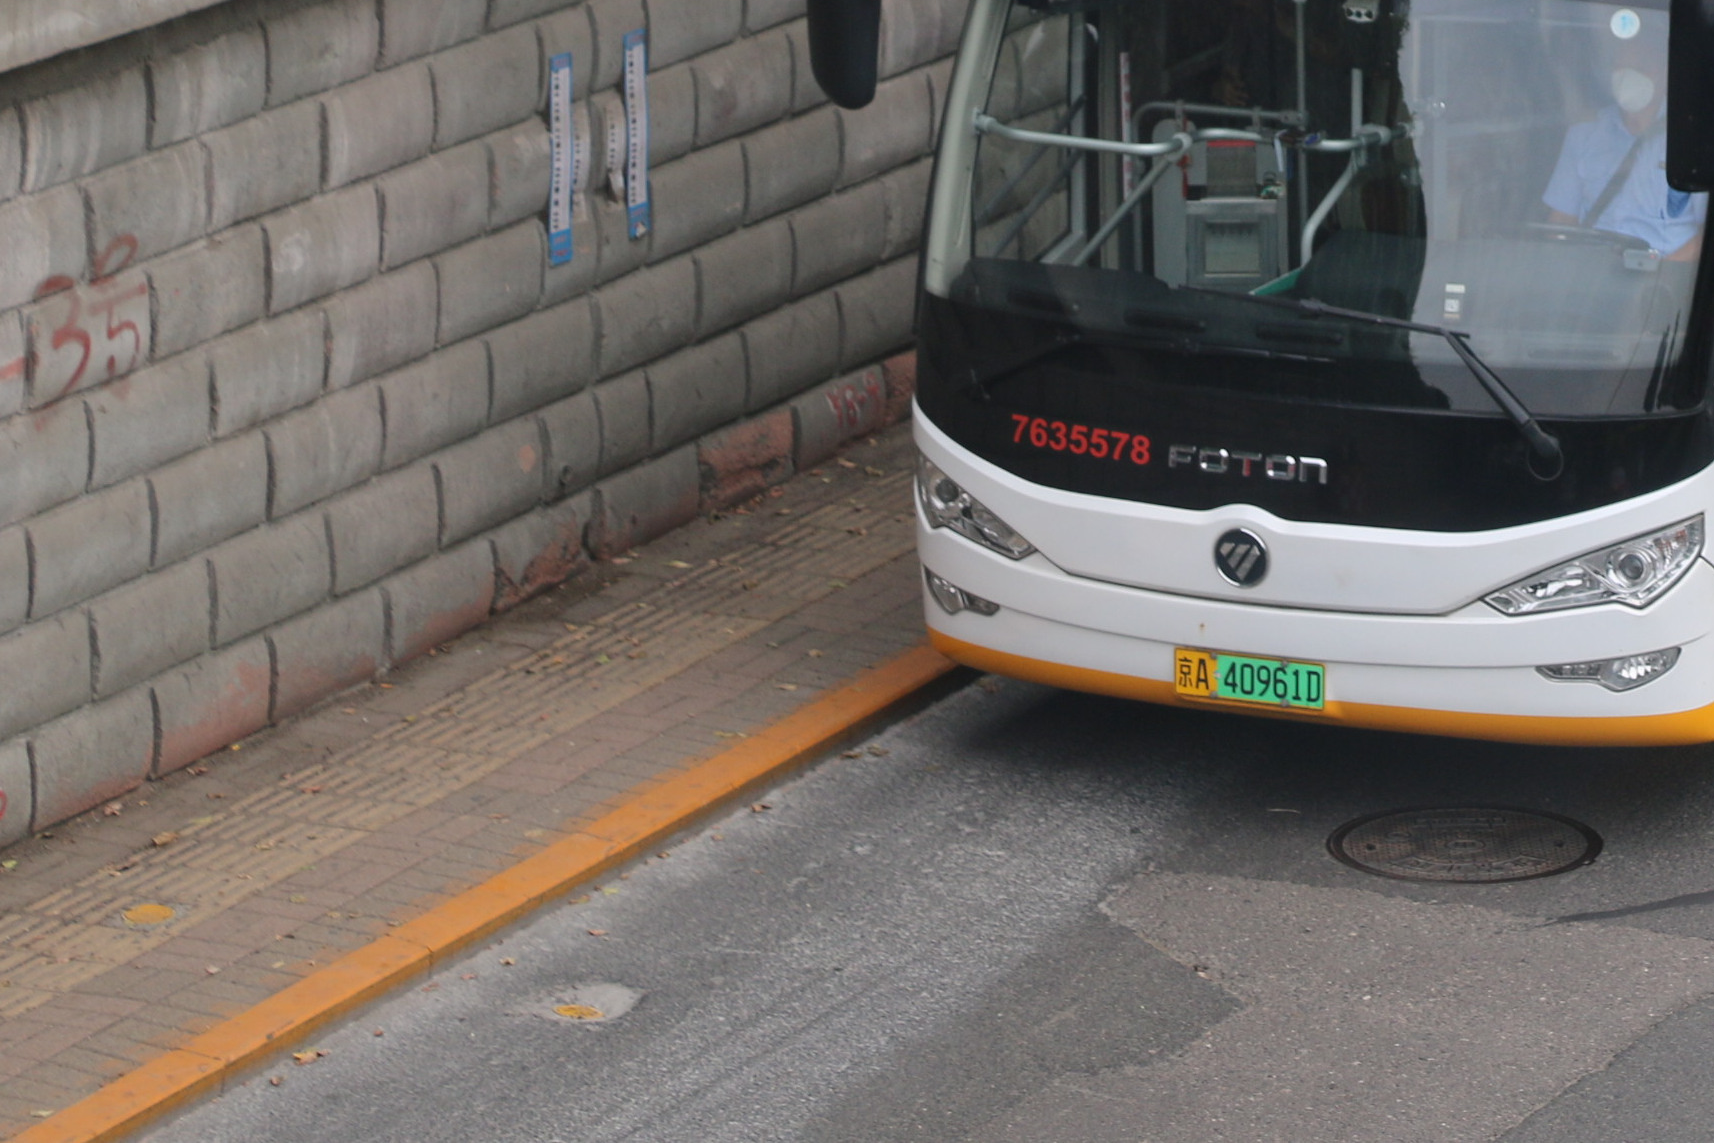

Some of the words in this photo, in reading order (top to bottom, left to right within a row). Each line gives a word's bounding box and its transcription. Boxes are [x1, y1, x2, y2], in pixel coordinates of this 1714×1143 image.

[1011, 413, 1151, 465] 7635578
[1168, 444, 1328, 485] FOTON
[1178, 655, 1210, 690] 京A
[1223, 661, 1321, 703] 40961D
